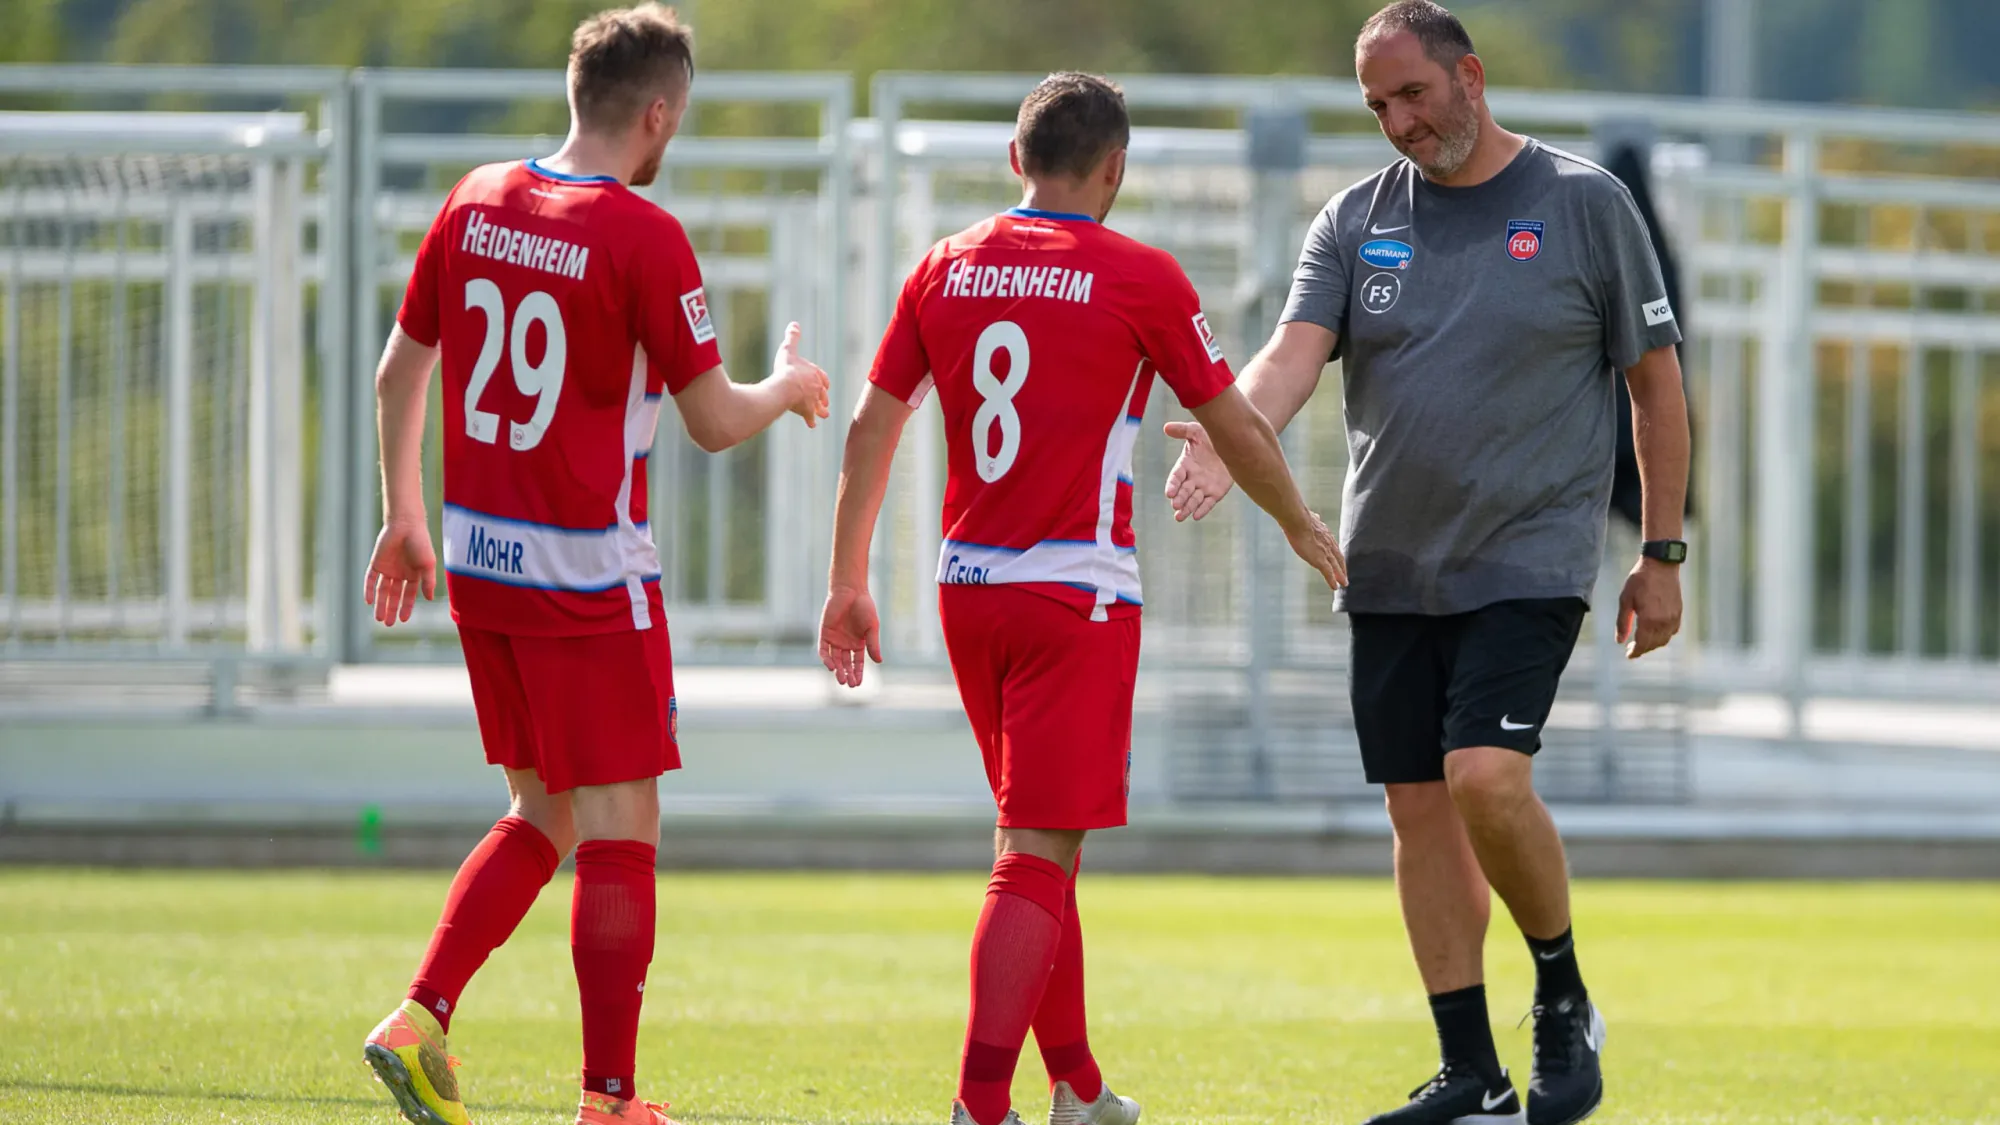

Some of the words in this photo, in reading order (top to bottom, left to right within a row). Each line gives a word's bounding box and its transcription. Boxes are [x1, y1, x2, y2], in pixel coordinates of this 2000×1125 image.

[1364, 247, 1410, 259] HARTMANN
[1512, 239, 1536, 252] FCH
[1368, 285, 1392, 303] FS
[464, 278, 567, 451] 29
[972, 320, 1030, 483] 8
